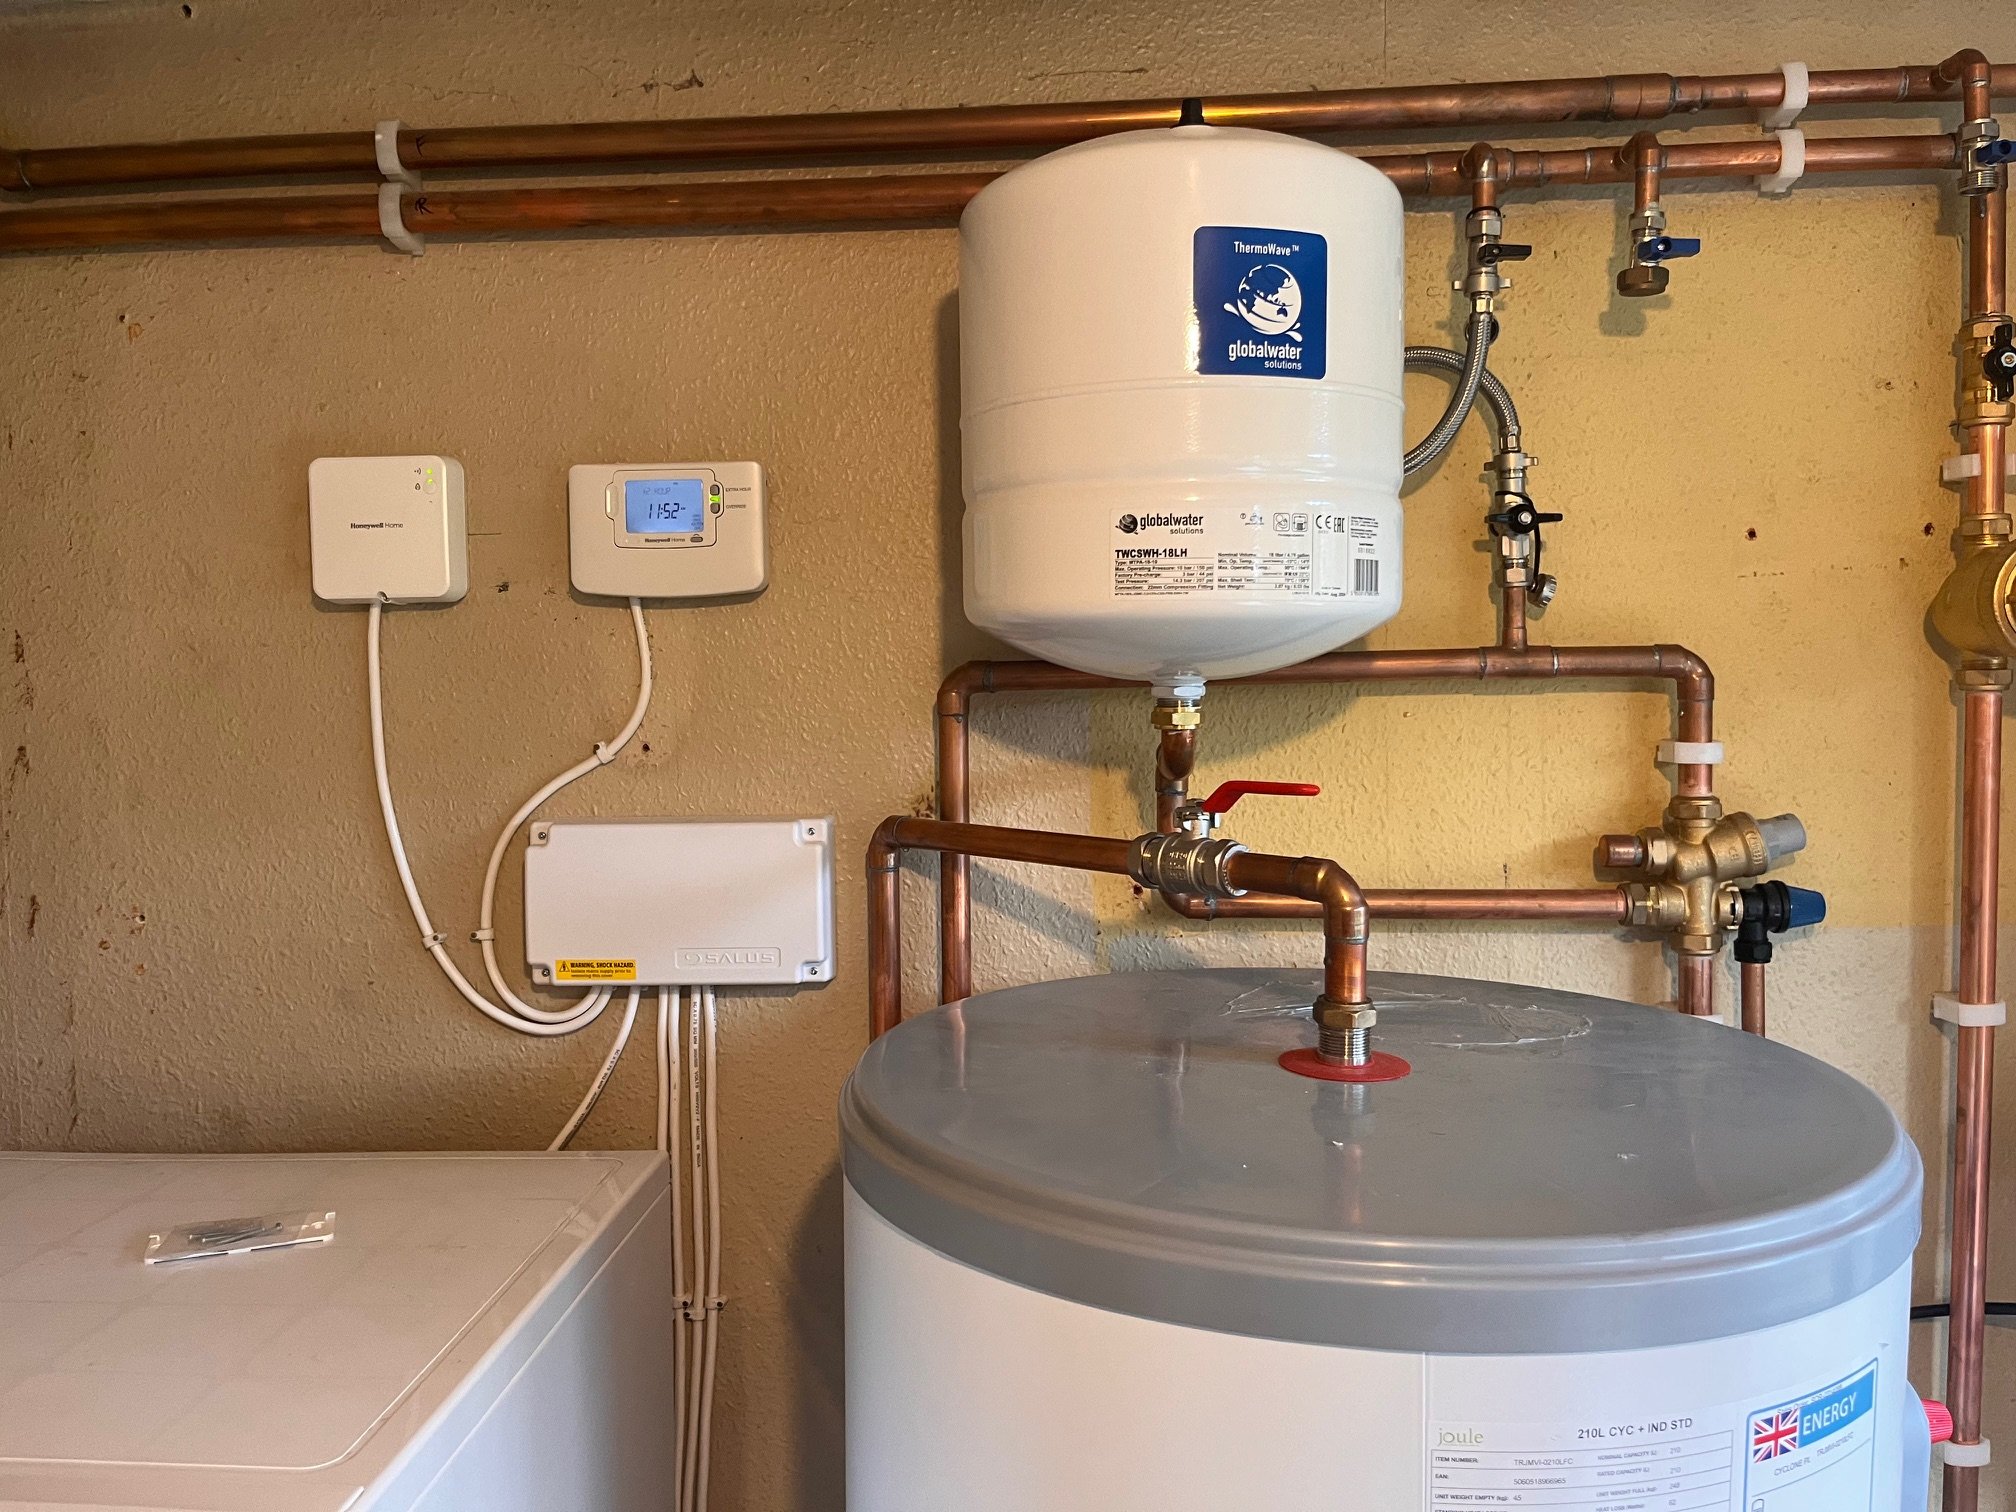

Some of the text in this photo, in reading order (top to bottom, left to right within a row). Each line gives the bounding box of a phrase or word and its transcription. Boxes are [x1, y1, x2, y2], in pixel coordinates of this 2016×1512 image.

[1228, 340, 1303, 362] globalwater
[1264, 360, 1302, 370] solutions
[648, 502, 680, 520] 11:52
[1140, 513, 1204, 530] globalwater
[1115, 548, 1188, 559] TWCSWH-18LH
[706, 951, 776, 965] SALUS
[1802, 1392, 1857, 1436] ENERGY
[1437, 1428, 1484, 1447] joule
[1578, 1428, 1605, 1439] 210L
[1609, 1426, 1634, 1436] CYC
[1648, 1421, 1667, 1433] IND
[1670, 1418, 1692, 1430] STD
